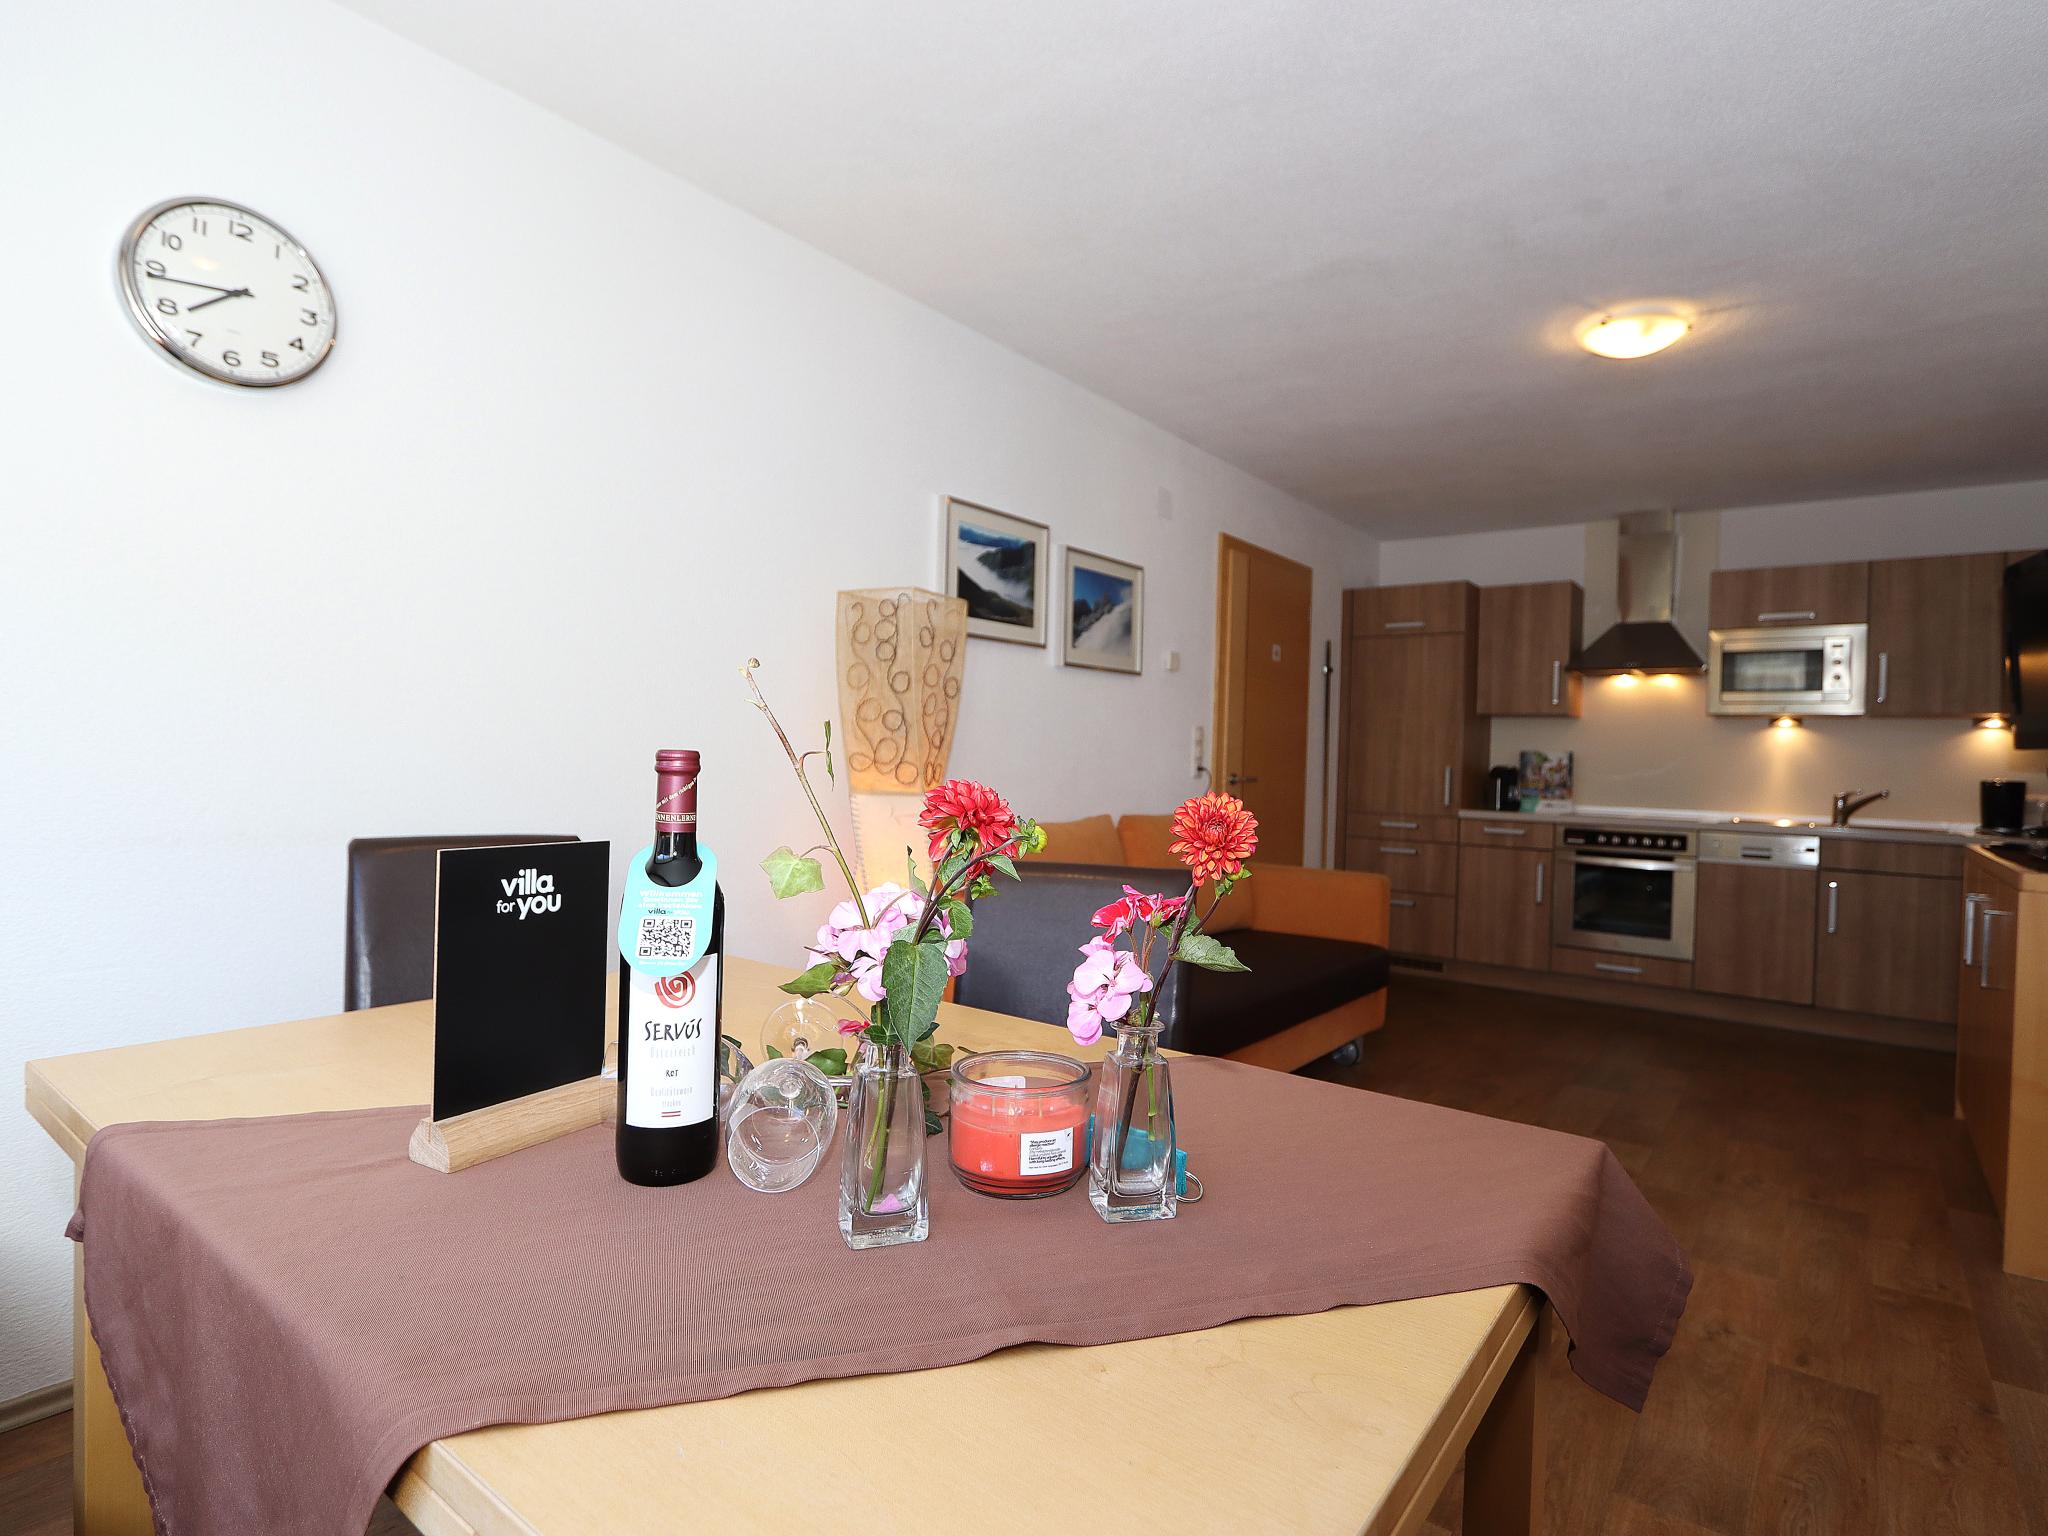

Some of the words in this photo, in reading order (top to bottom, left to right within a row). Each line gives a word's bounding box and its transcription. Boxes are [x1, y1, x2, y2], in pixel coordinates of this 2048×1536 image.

[192, 217, 207, 236] 11
[229, 219, 253, 242] 12
[161, 230, 182, 251] 10
[274, 245, 281, 259] 1
[145, 259, 166, 279] 9
[292, 274, 309, 293] 2
[157, 298, 178, 316] 8
[300, 308, 318, 326] 3
[186, 328, 203, 347] 7
[288, 337, 304, 351] 4
[222, 350, 241, 367] 6
[261, 351, 280, 368] 5
[500, 868, 555, 897] villa
[496, 899, 516, 914] for
[516, 893, 562, 921] you
[665, 1069, 679, 1078] ROT
